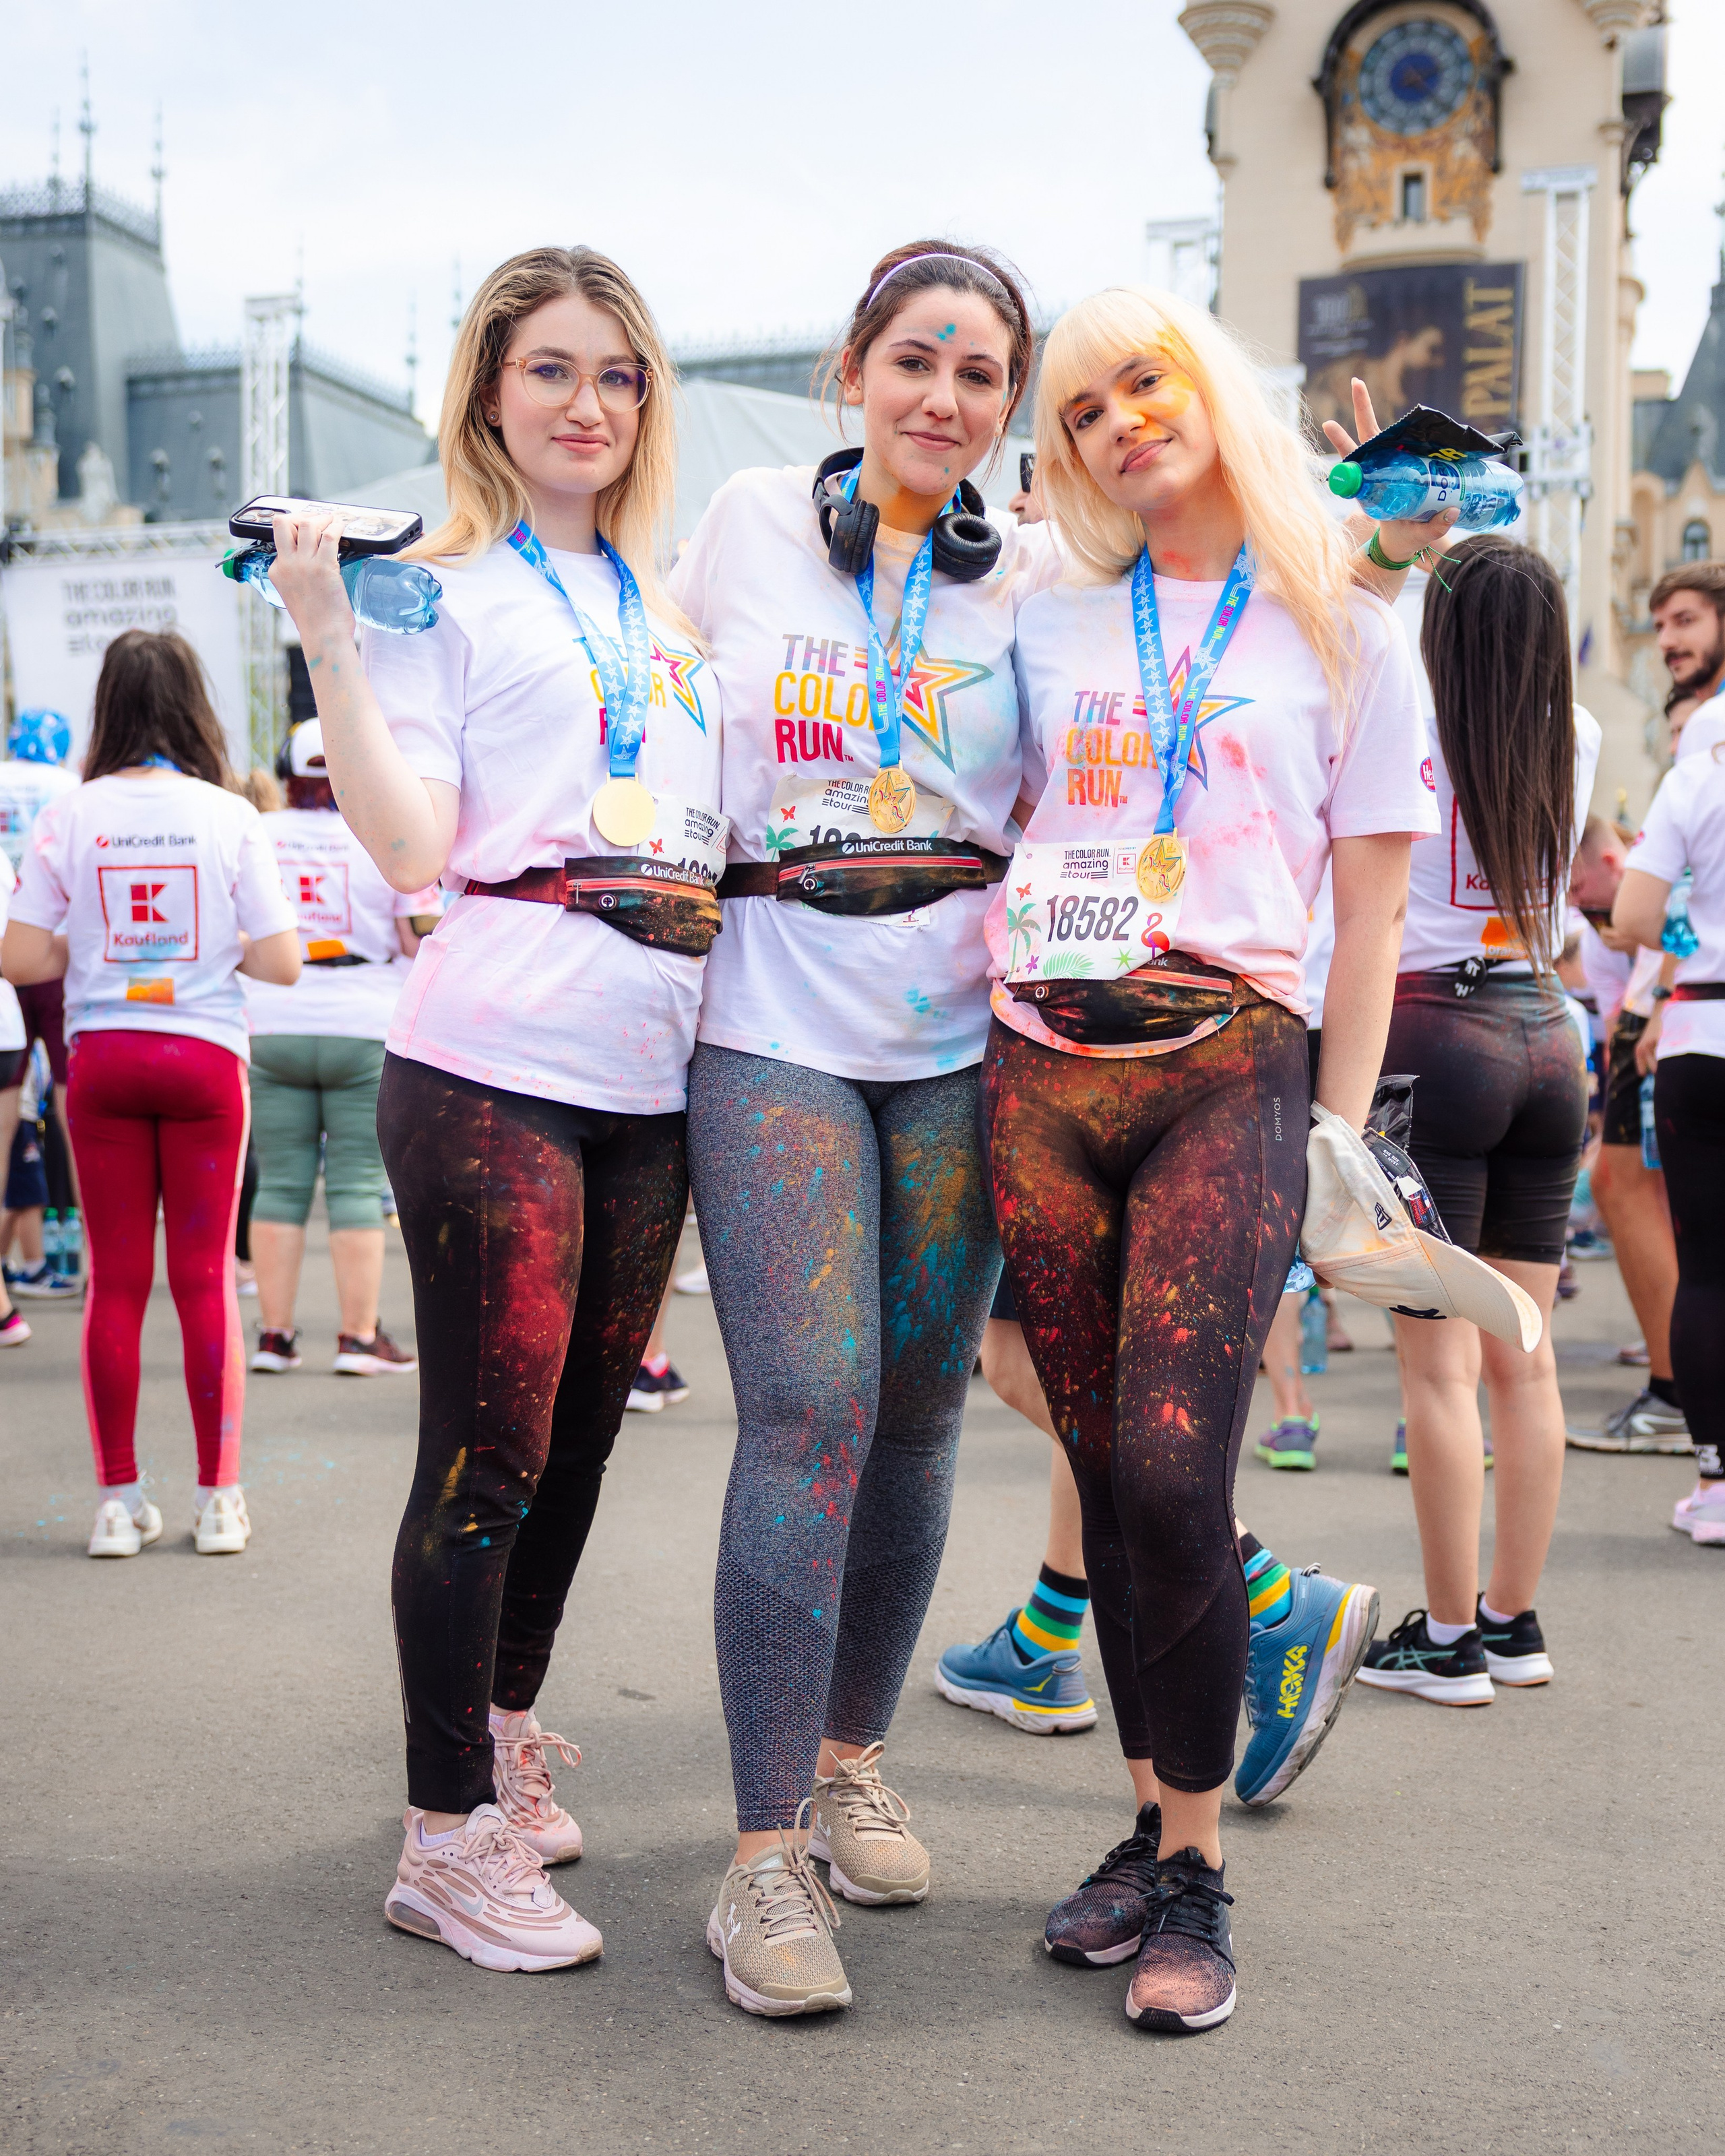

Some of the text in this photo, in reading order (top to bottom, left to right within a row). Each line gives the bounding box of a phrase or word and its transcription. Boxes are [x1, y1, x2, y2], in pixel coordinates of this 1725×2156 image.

[1212, 596, 1239, 640] THE COLOR RUN
[782, 633, 848, 677] THE
[875, 666, 888, 717] THE COLOR RUN
[774, 672, 875, 731] COLO
[1073, 691, 1126, 726] THE
[1178, 687, 1199, 741] THE COLOR RUN
[774, 719, 842, 763] RUN
[827, 780, 841, 788] THE
[841, 780, 865, 793] COLOR
[1067, 769, 1123, 808] RUN
[825, 788, 870, 808] amazin
[829, 798, 852, 811] tour
[686, 807, 695, 819] THE
[685, 819, 714, 837] amazing
[112, 835, 197, 848] UniCredit Bank
[855, 839, 933, 853] UniCredit Bank
[1063, 858, 1108, 870] amazing
[1065, 850, 1075, 860] THE
[1075, 849, 1096, 859] COLOR
[653, 865, 689, 883] UniCredit
[689, 871, 705, 887] Bank
[1067, 870, 1090, 879] tour
[1046, 895, 1139, 943] 18582
[114, 931, 189, 947] Kaufland
[1147, 957, 1168, 967] ank
[1274, 1098, 1282, 1141] DOMYOS
[1388, 1157, 1399, 1166] MOST
[1391, 1155, 1400, 1163] SIZE
[1277, 1645, 1308, 1718] HOKA
